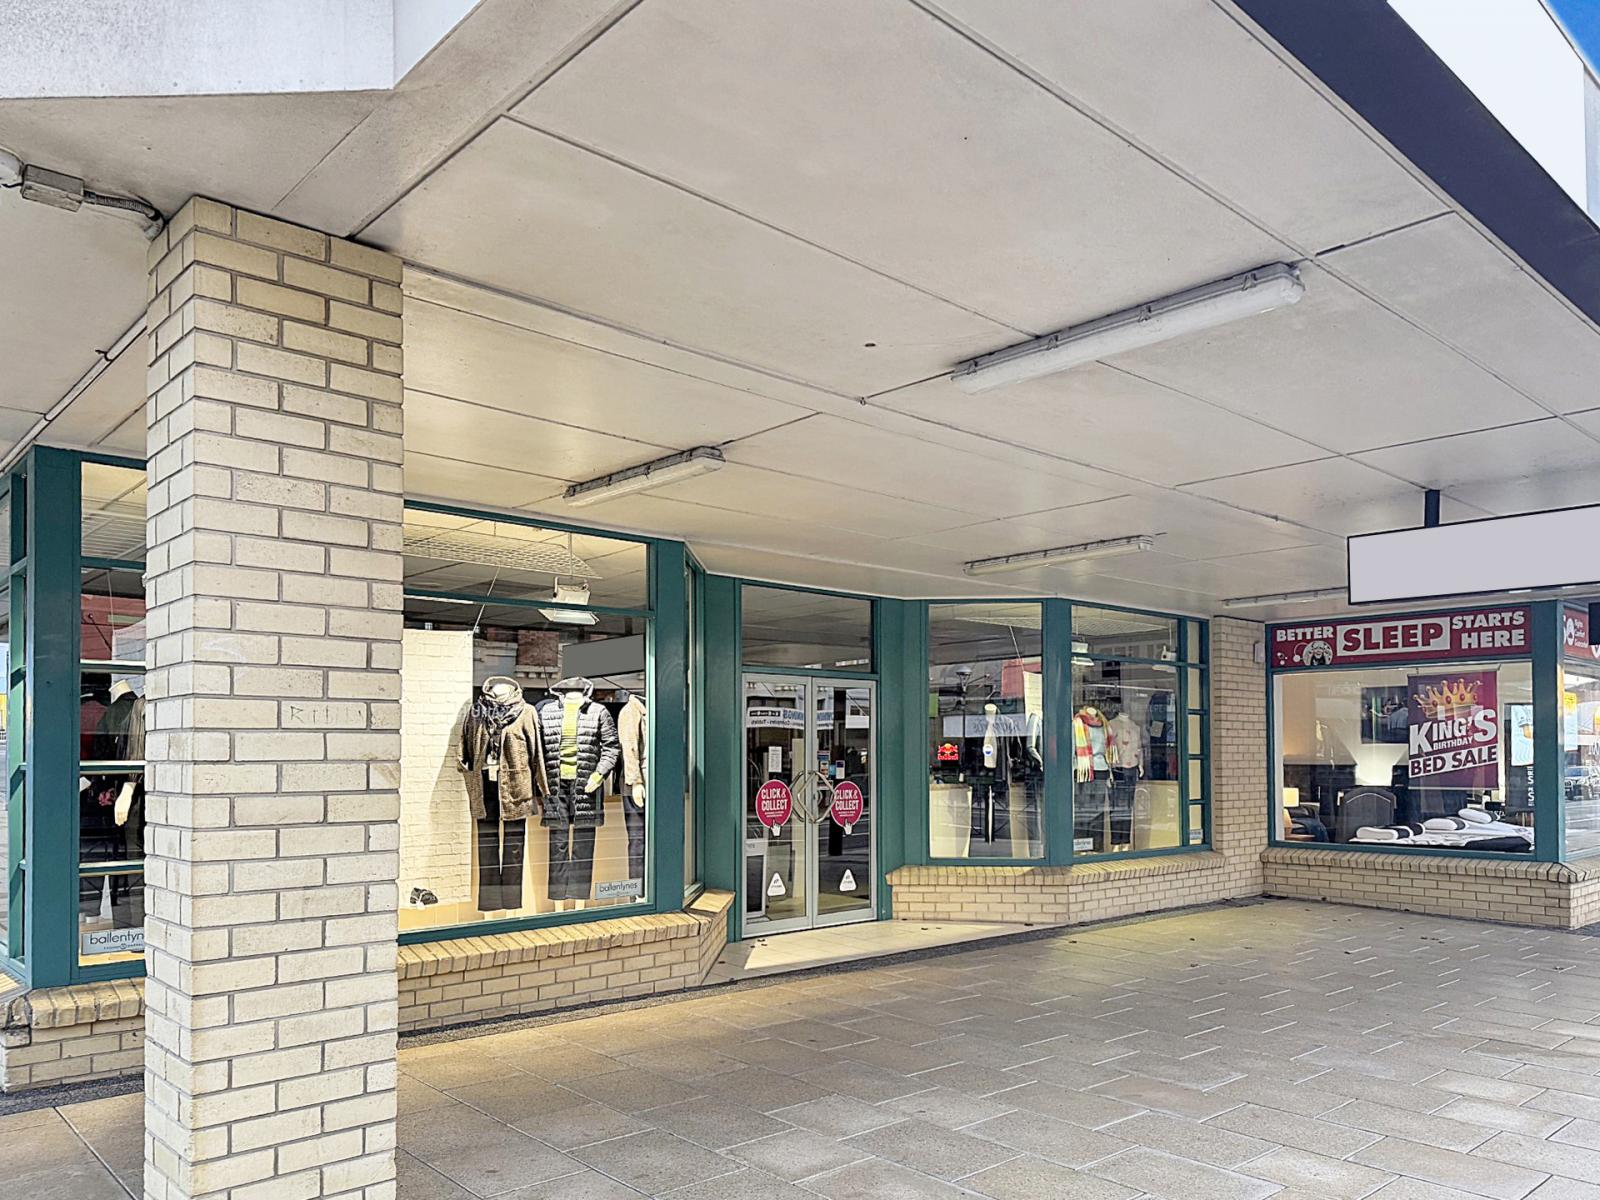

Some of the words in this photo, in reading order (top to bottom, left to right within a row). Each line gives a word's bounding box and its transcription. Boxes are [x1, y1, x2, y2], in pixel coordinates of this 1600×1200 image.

[1276, 626, 1334, 642] BETTER
[1342, 622, 1443, 651] SLEEP
[1452, 611, 1525, 630] STARTS
[1461, 629, 1525, 649] HERE
[1409, 709, 1497, 756] KING'S
[1433, 736, 1473, 751] BIRTHDAY
[1411, 756, 1446, 776] BED
[1452, 745, 1497, 769] SALE
[761, 788, 781, 799] CLICK
[780, 788, 787, 799] &
[834, 789, 853, 800] CLICK
[761, 799, 788, 811] COLLECT
[835, 800, 859, 811] COLLECT
